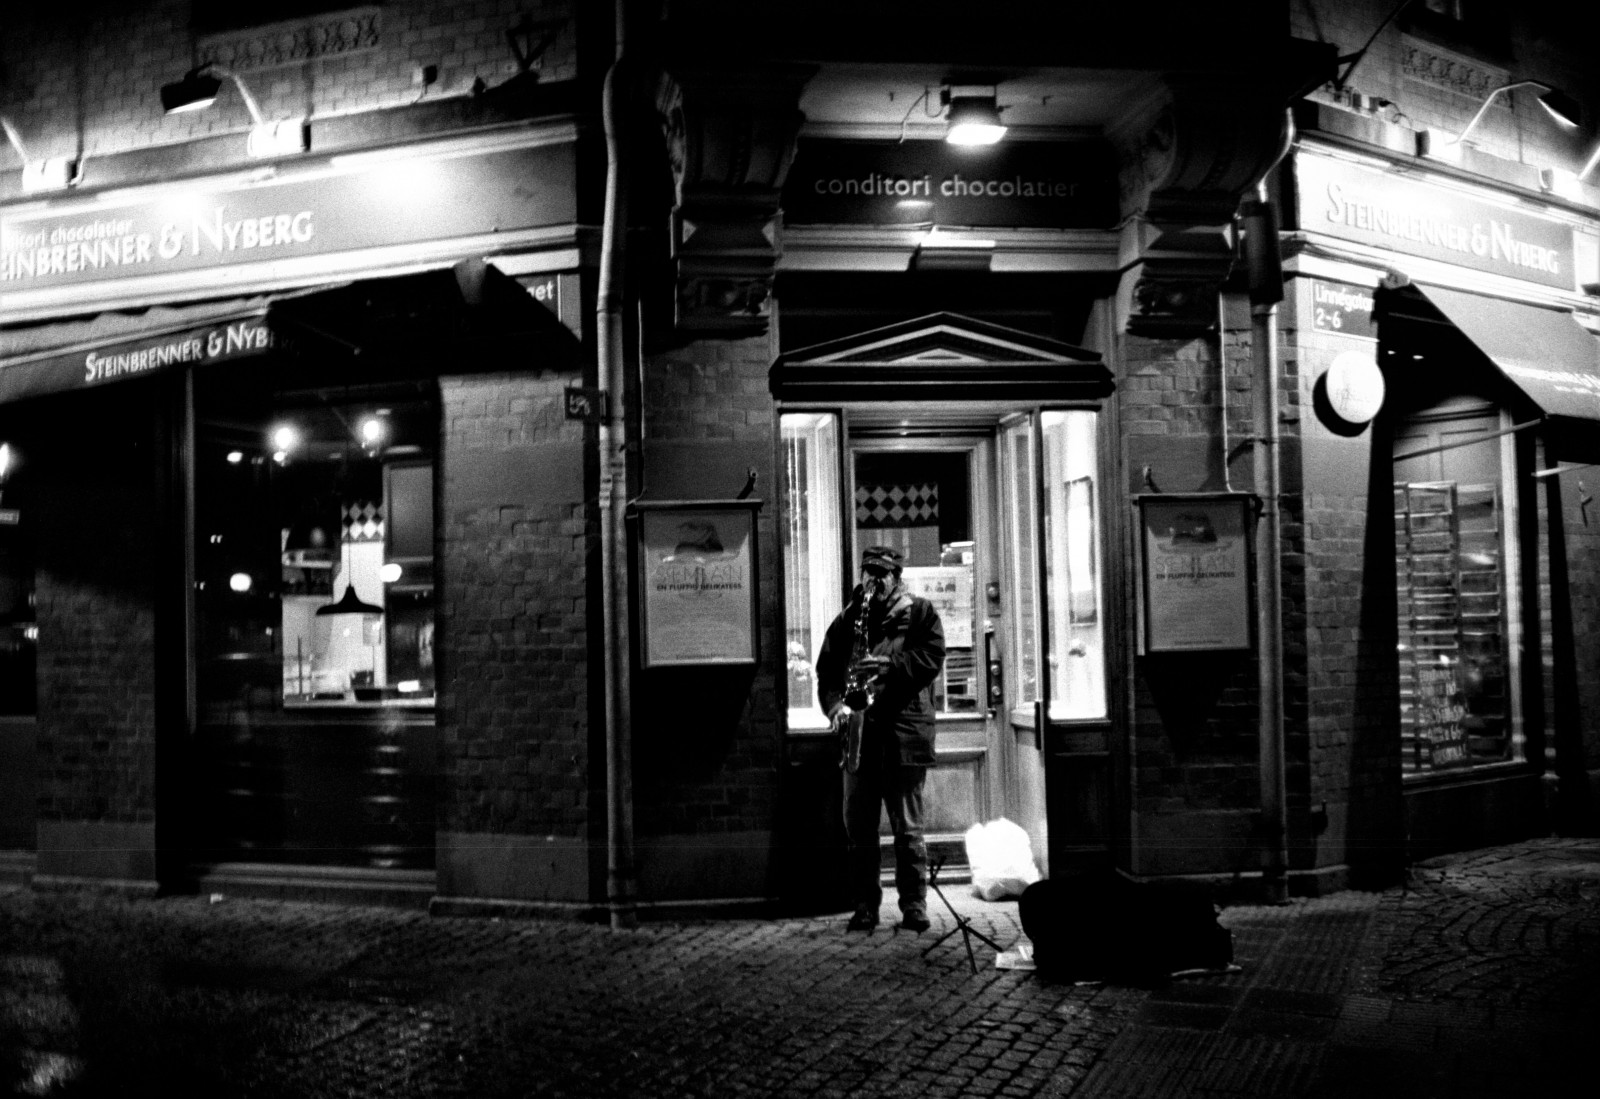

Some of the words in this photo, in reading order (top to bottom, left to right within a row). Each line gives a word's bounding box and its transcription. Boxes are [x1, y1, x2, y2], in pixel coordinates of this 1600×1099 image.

[814, 173, 931, 196] conditori
[940, 174, 1079, 197] chocolatier
[50, 219, 134, 245] chocolatier
[159, 223, 184, 260] &
[192, 206, 314, 256] NYBERG
[1471, 223, 1490, 256] &
[1316, 307, 1342, 329] 2-6
[207, 331, 223, 357] &
